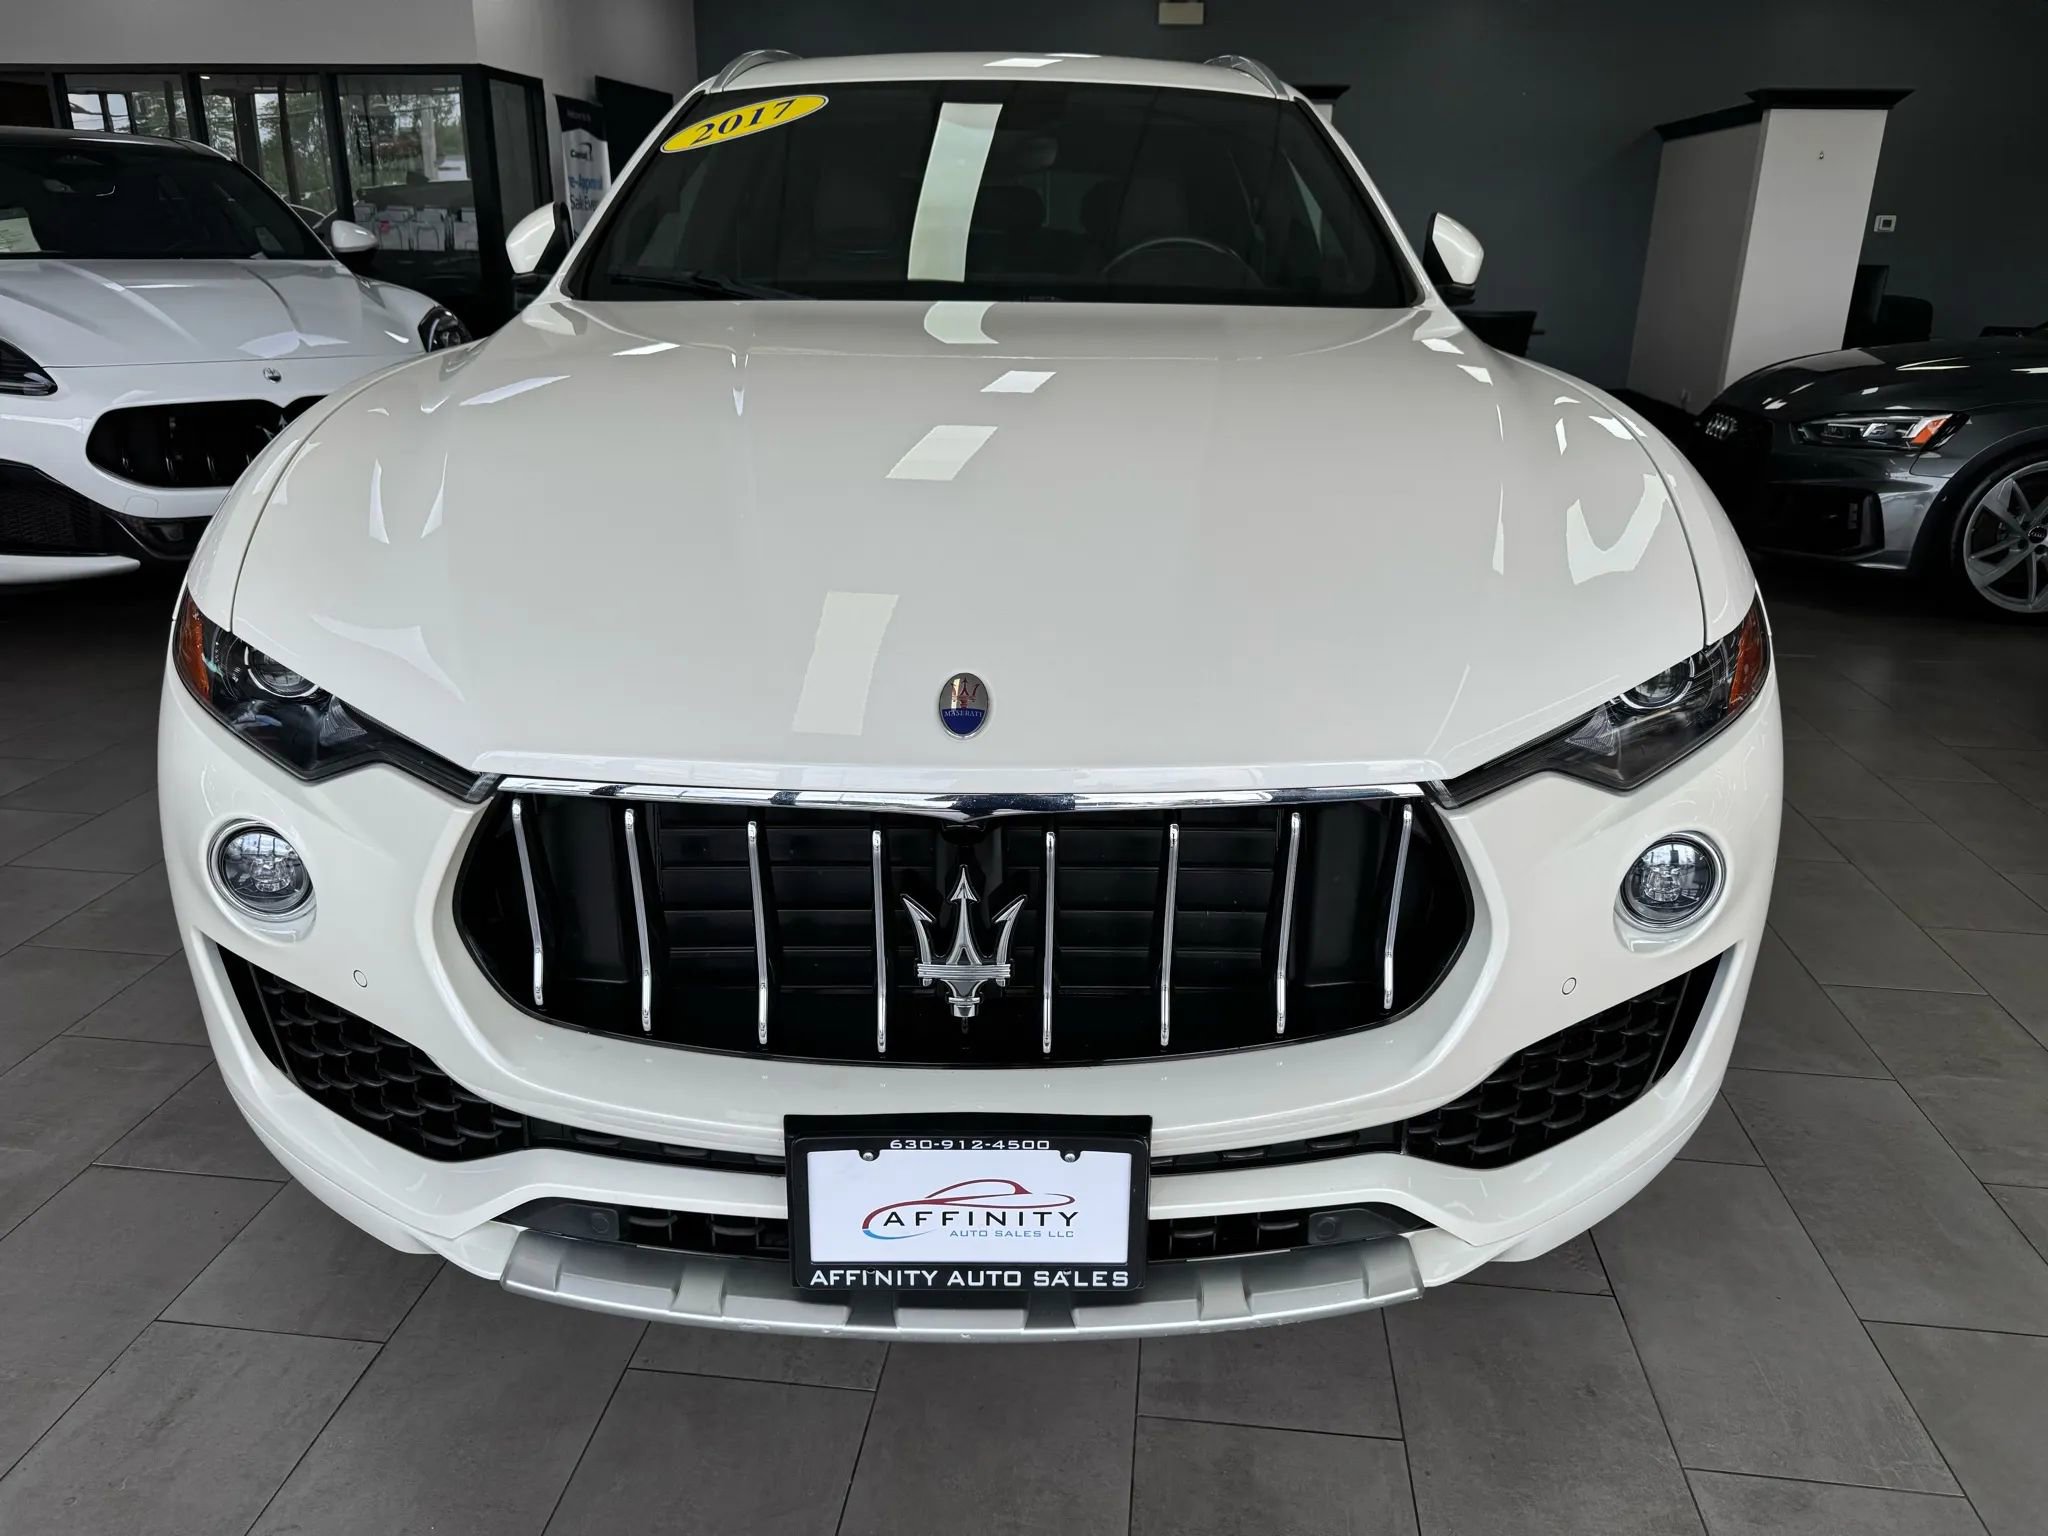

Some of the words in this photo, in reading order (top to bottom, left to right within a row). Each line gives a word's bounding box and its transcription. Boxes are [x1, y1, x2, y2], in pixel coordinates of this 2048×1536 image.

[690, 98, 798, 146] 2017
[890, 1139, 1050, 1149] 630-912-4500
[883, 1211, 1079, 1226] AFFINITY
[949, 1230, 988, 1238] AUTO
[994, 1230, 1042, 1238] SALES
[1048, 1230, 1075, 1238] LLC
[810, 1269, 938, 1286] AFFINITY
[947, 1270, 1022, 1287] AUTO
[1033, 1270, 1129, 1287] SALES
